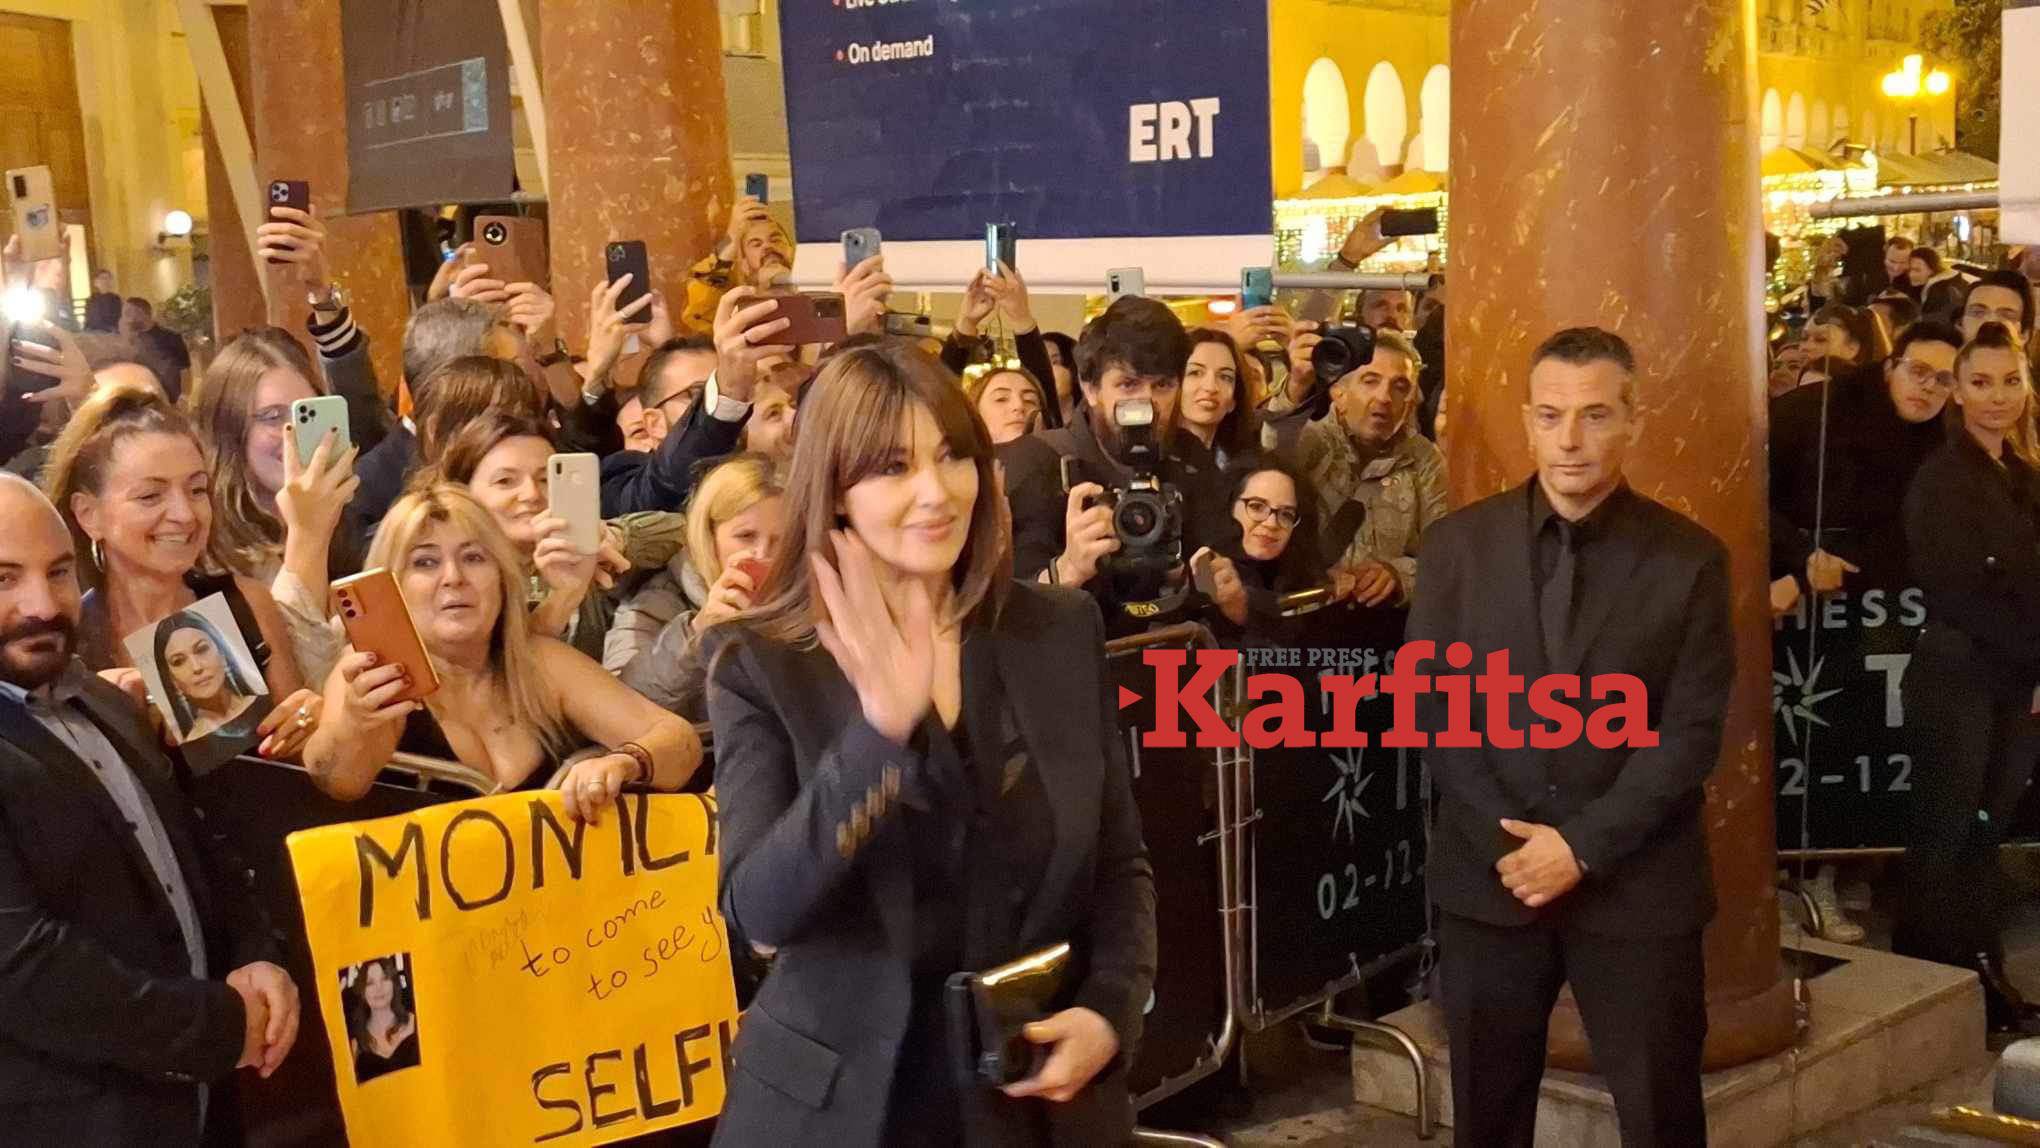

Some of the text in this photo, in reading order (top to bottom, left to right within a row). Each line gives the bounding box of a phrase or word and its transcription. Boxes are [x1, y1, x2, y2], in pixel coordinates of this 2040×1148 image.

[847, 34, 934, 64] On demand
[1129, 97, 1221, 163] ERT
[520, 939, 571, 978] to
[586, 888, 667, 949] come
[587, 969, 628, 1001] to
[643, 924, 696, 978] see
